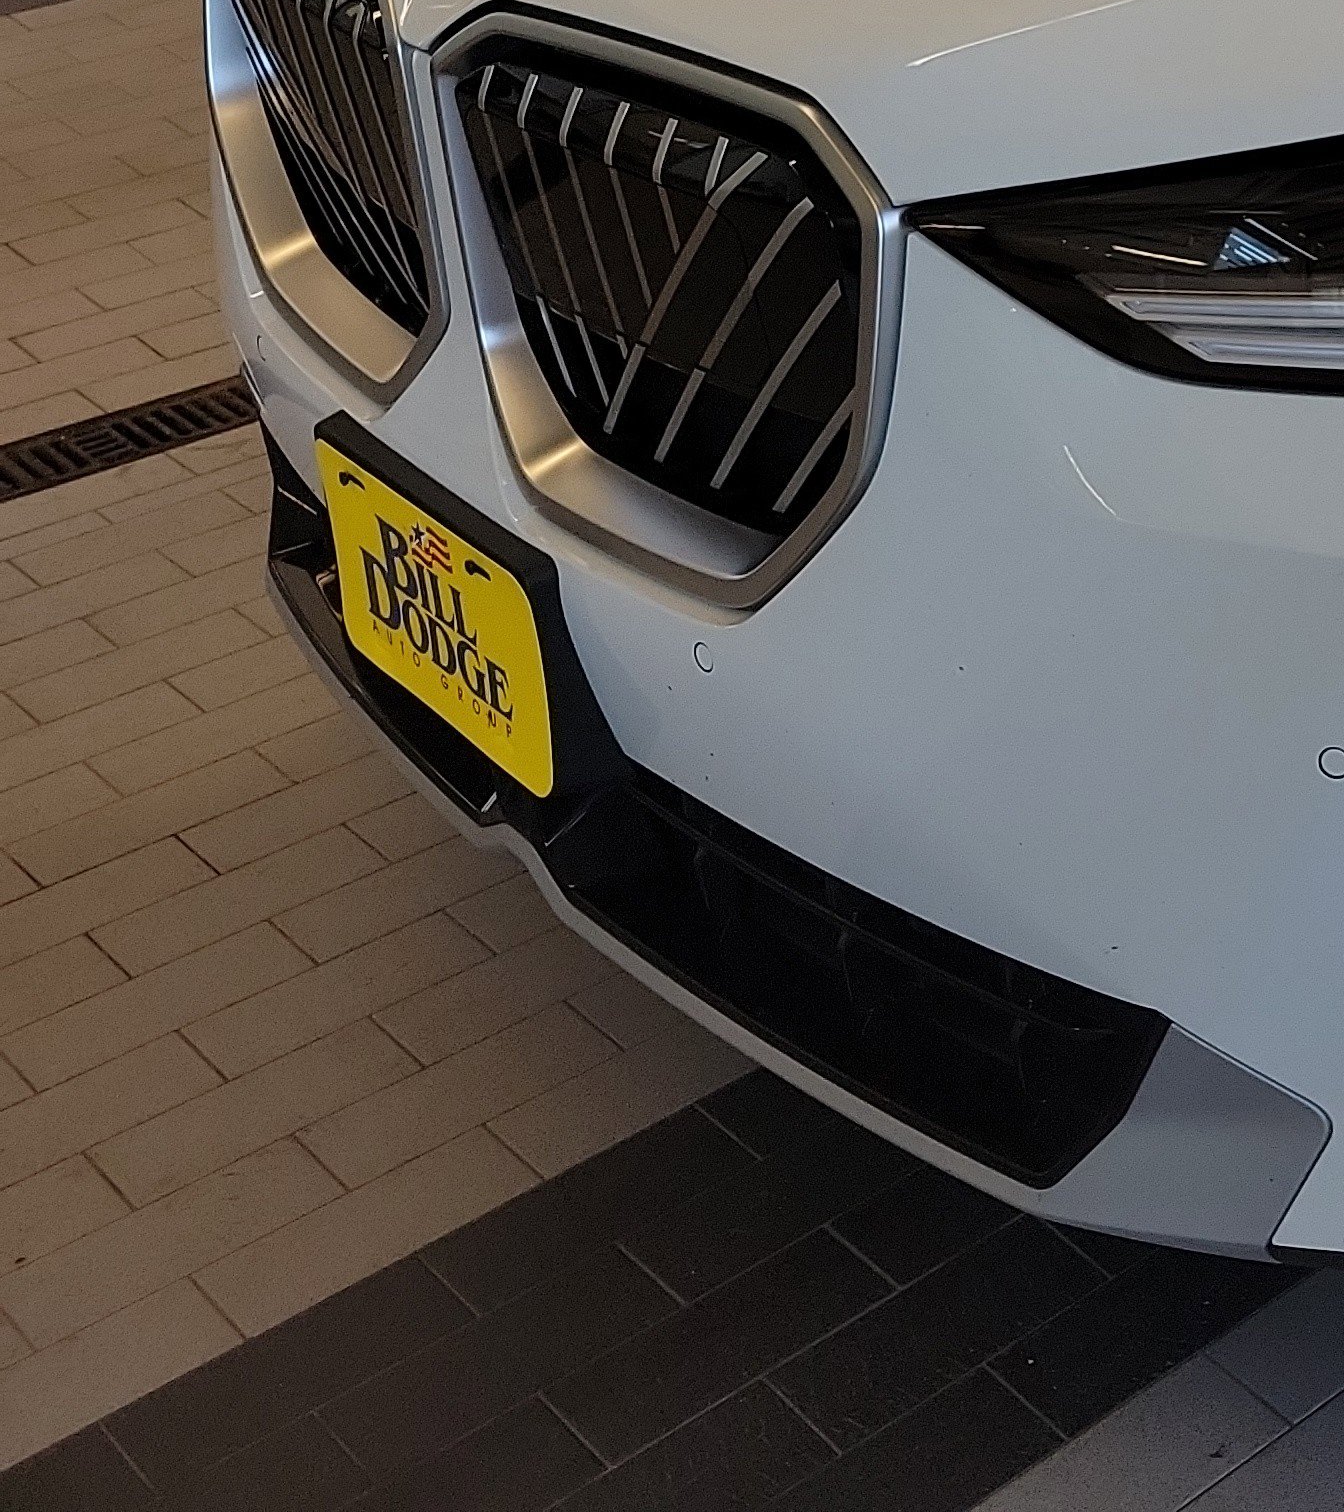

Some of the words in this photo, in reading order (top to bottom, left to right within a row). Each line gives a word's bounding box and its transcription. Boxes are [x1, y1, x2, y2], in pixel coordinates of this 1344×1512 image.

[359, 545, 513, 722] DODGE
[372, 619, 421, 668] AUTO
[374, 513, 477, 648] BILL
